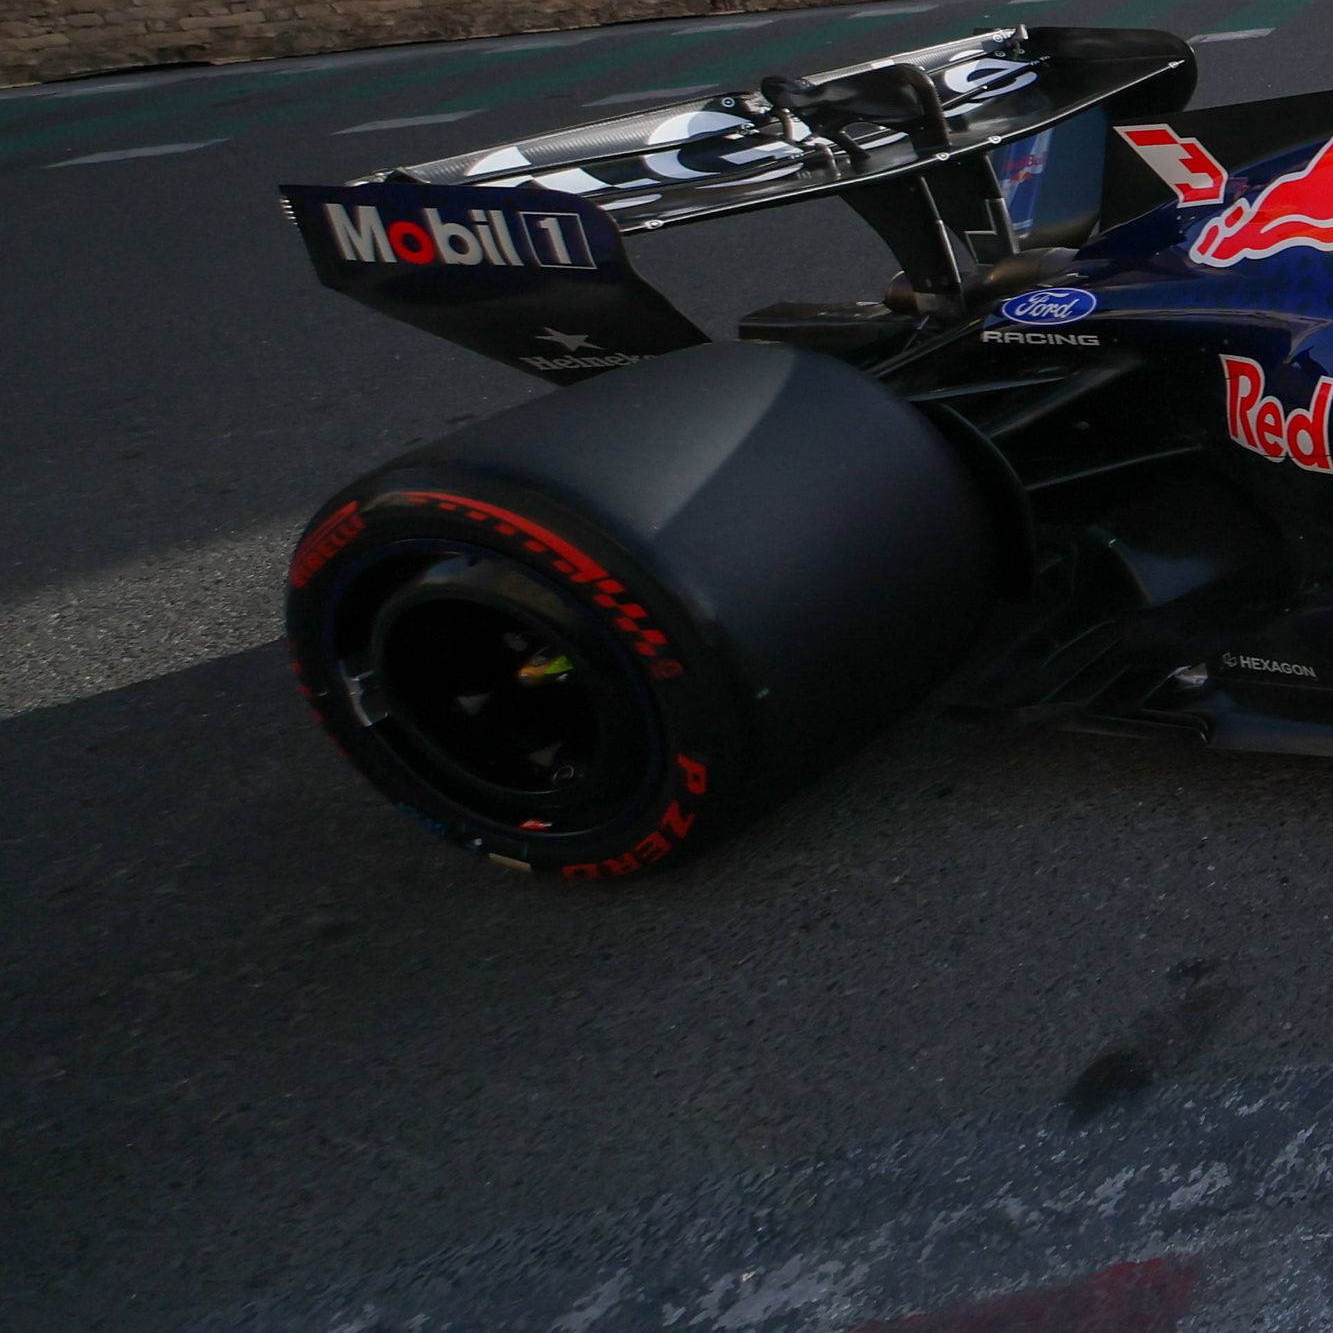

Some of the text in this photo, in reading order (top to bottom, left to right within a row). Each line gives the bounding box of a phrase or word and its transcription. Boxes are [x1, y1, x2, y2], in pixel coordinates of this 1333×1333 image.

[323, 203, 526, 268] Mobil
[1014, 291, 1081, 319] Ford
[983, 330, 1101, 346] RACING
[519, 352, 660, 371] Heinek
[1223, 355, 1333, 471] Red
[289, 500, 367, 588] PIRELLI
[1239, 654, 1317, 679] HEXAGON
[560, 752, 708, 882] P ZERO
